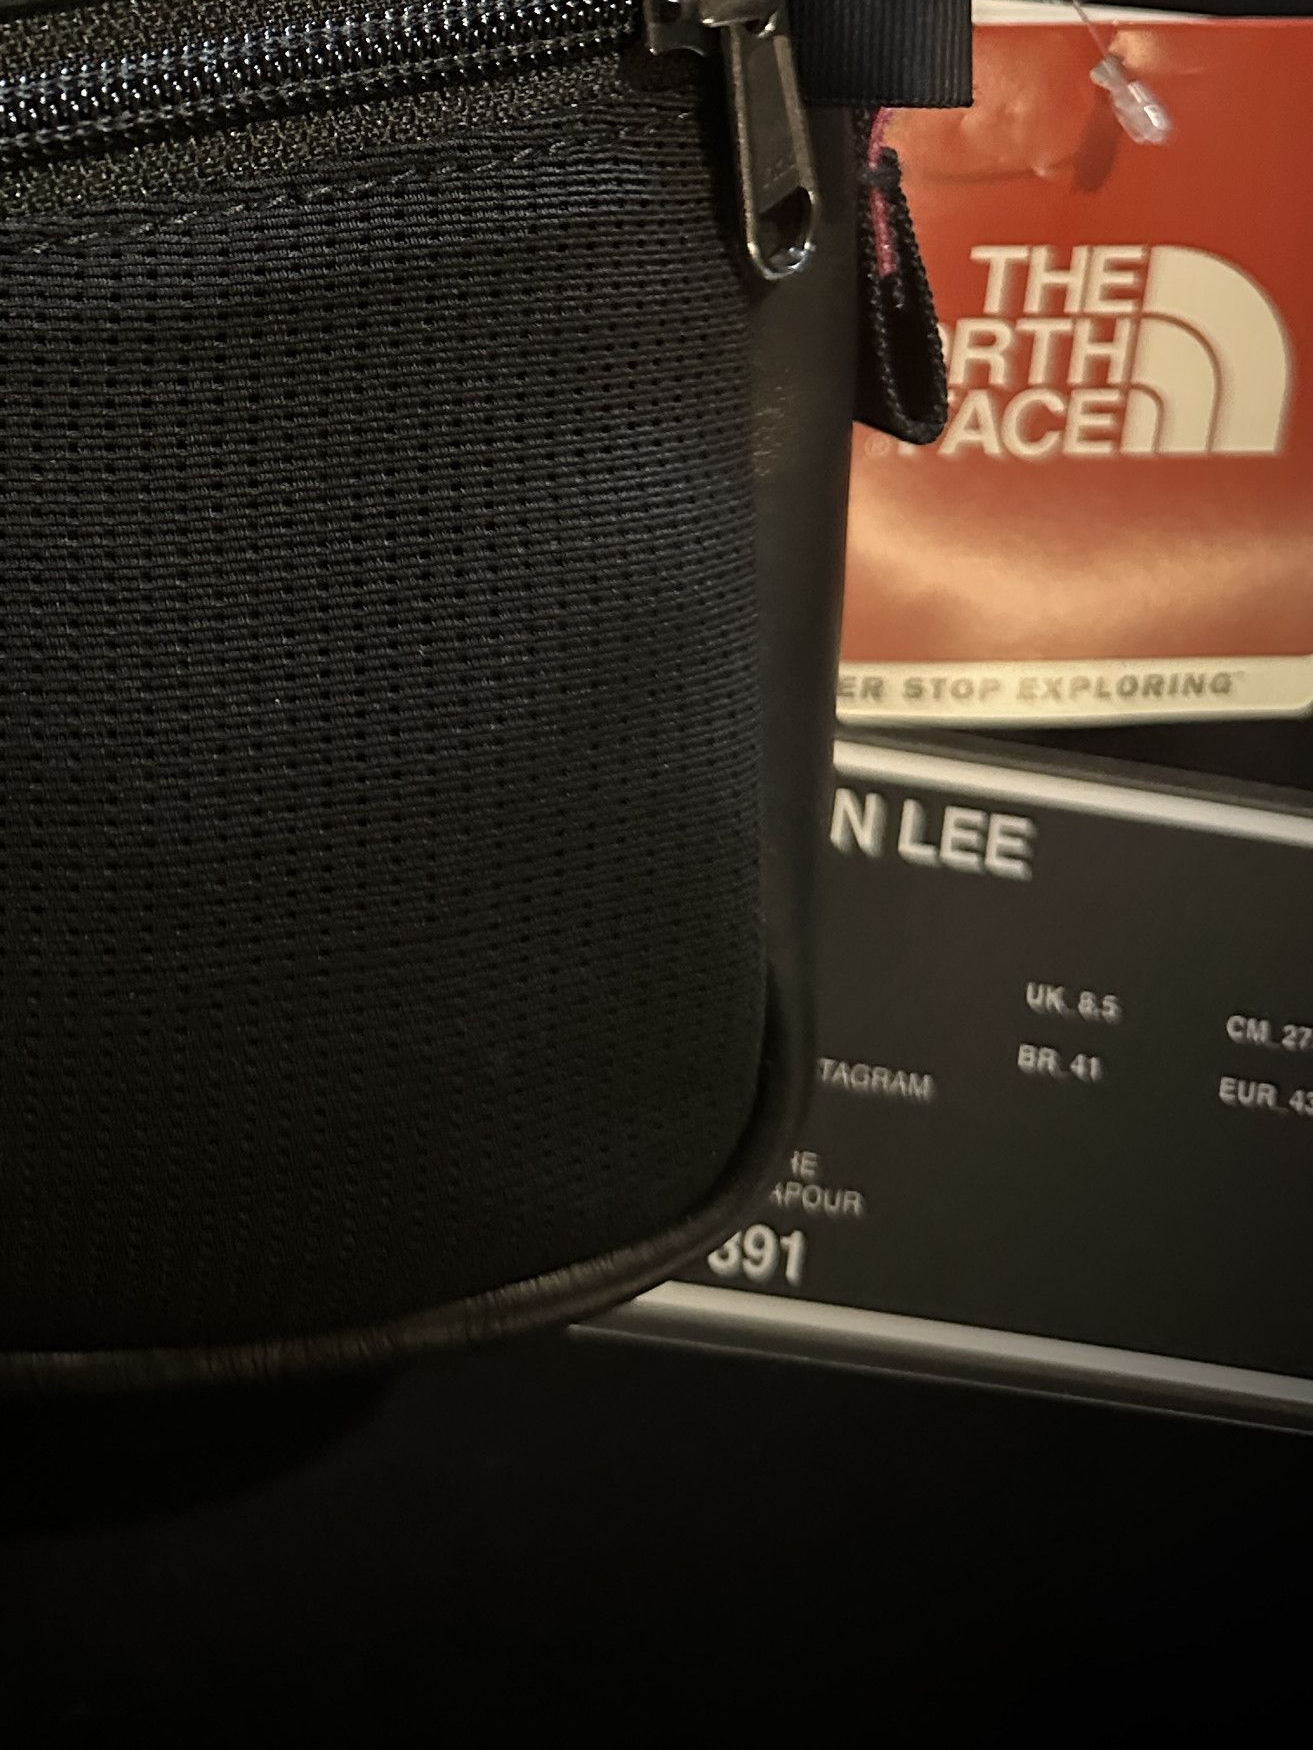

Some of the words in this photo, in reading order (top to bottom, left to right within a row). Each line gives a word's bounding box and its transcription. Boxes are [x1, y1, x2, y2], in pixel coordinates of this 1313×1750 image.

[969, 244, 1146, 316] THE
[938, 316, 1133, 387] RTH
[918, 387, 1122, 458] ACE
[902, 676, 1001, 702] STOP
[1016, 670, 1236, 702] EXPLORING
[897, 798, 1038, 882] LEE
